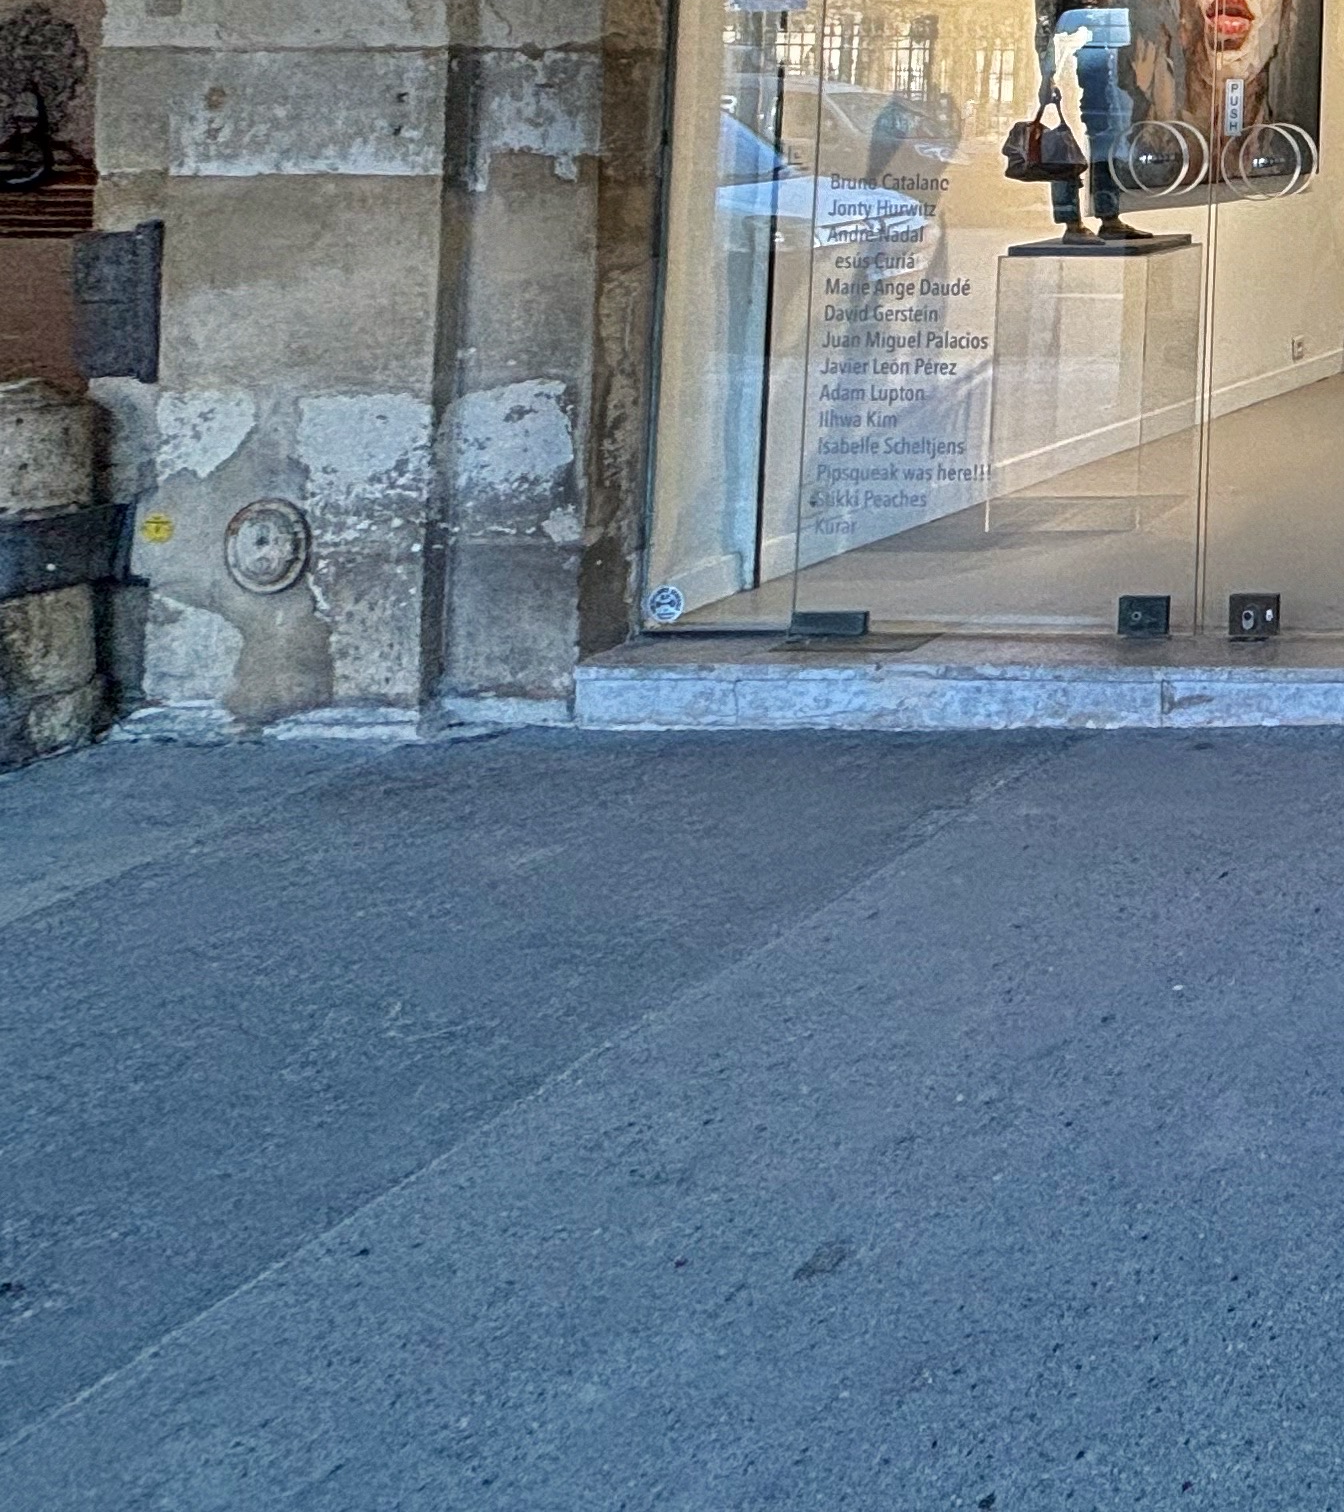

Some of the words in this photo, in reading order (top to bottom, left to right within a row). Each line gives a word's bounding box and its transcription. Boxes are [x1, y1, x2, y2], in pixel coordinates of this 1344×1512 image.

[1229, 83, 1239, 131] PUSH
[830, 173, 878, 191] Bruno
[827, 200, 872, 218] Jonty
[876, 201, 936, 217] Hurwitz
[878, 225, 925, 243] Nadal
[824, 278, 871, 296] Marie
[873, 278, 916, 301] Ange
[919, 278, 971, 297] Daudé
[823, 304, 869, 323] David
[872, 306, 939, 323] Gerstein
[821, 332, 861, 350] Juan
[865, 332, 922, 353] Miguel
[925, 331, 990, 350] Palacios
[819, 358, 869, 376] Javier
[872, 358, 911, 376] León
[914, 357, 958, 376] Pérez
[818, 384, 866, 402] Adam
[869, 384, 926, 406] Lupton
[866, 410, 898, 428] Kim
[817, 436, 880, 455] Isabelle
[883, 437, 966, 460] Scheltjens
[815, 464, 900, 485] Pipsqueak
[902, 468, 934, 481] was
[863, 489, 928, 508] Peaches
